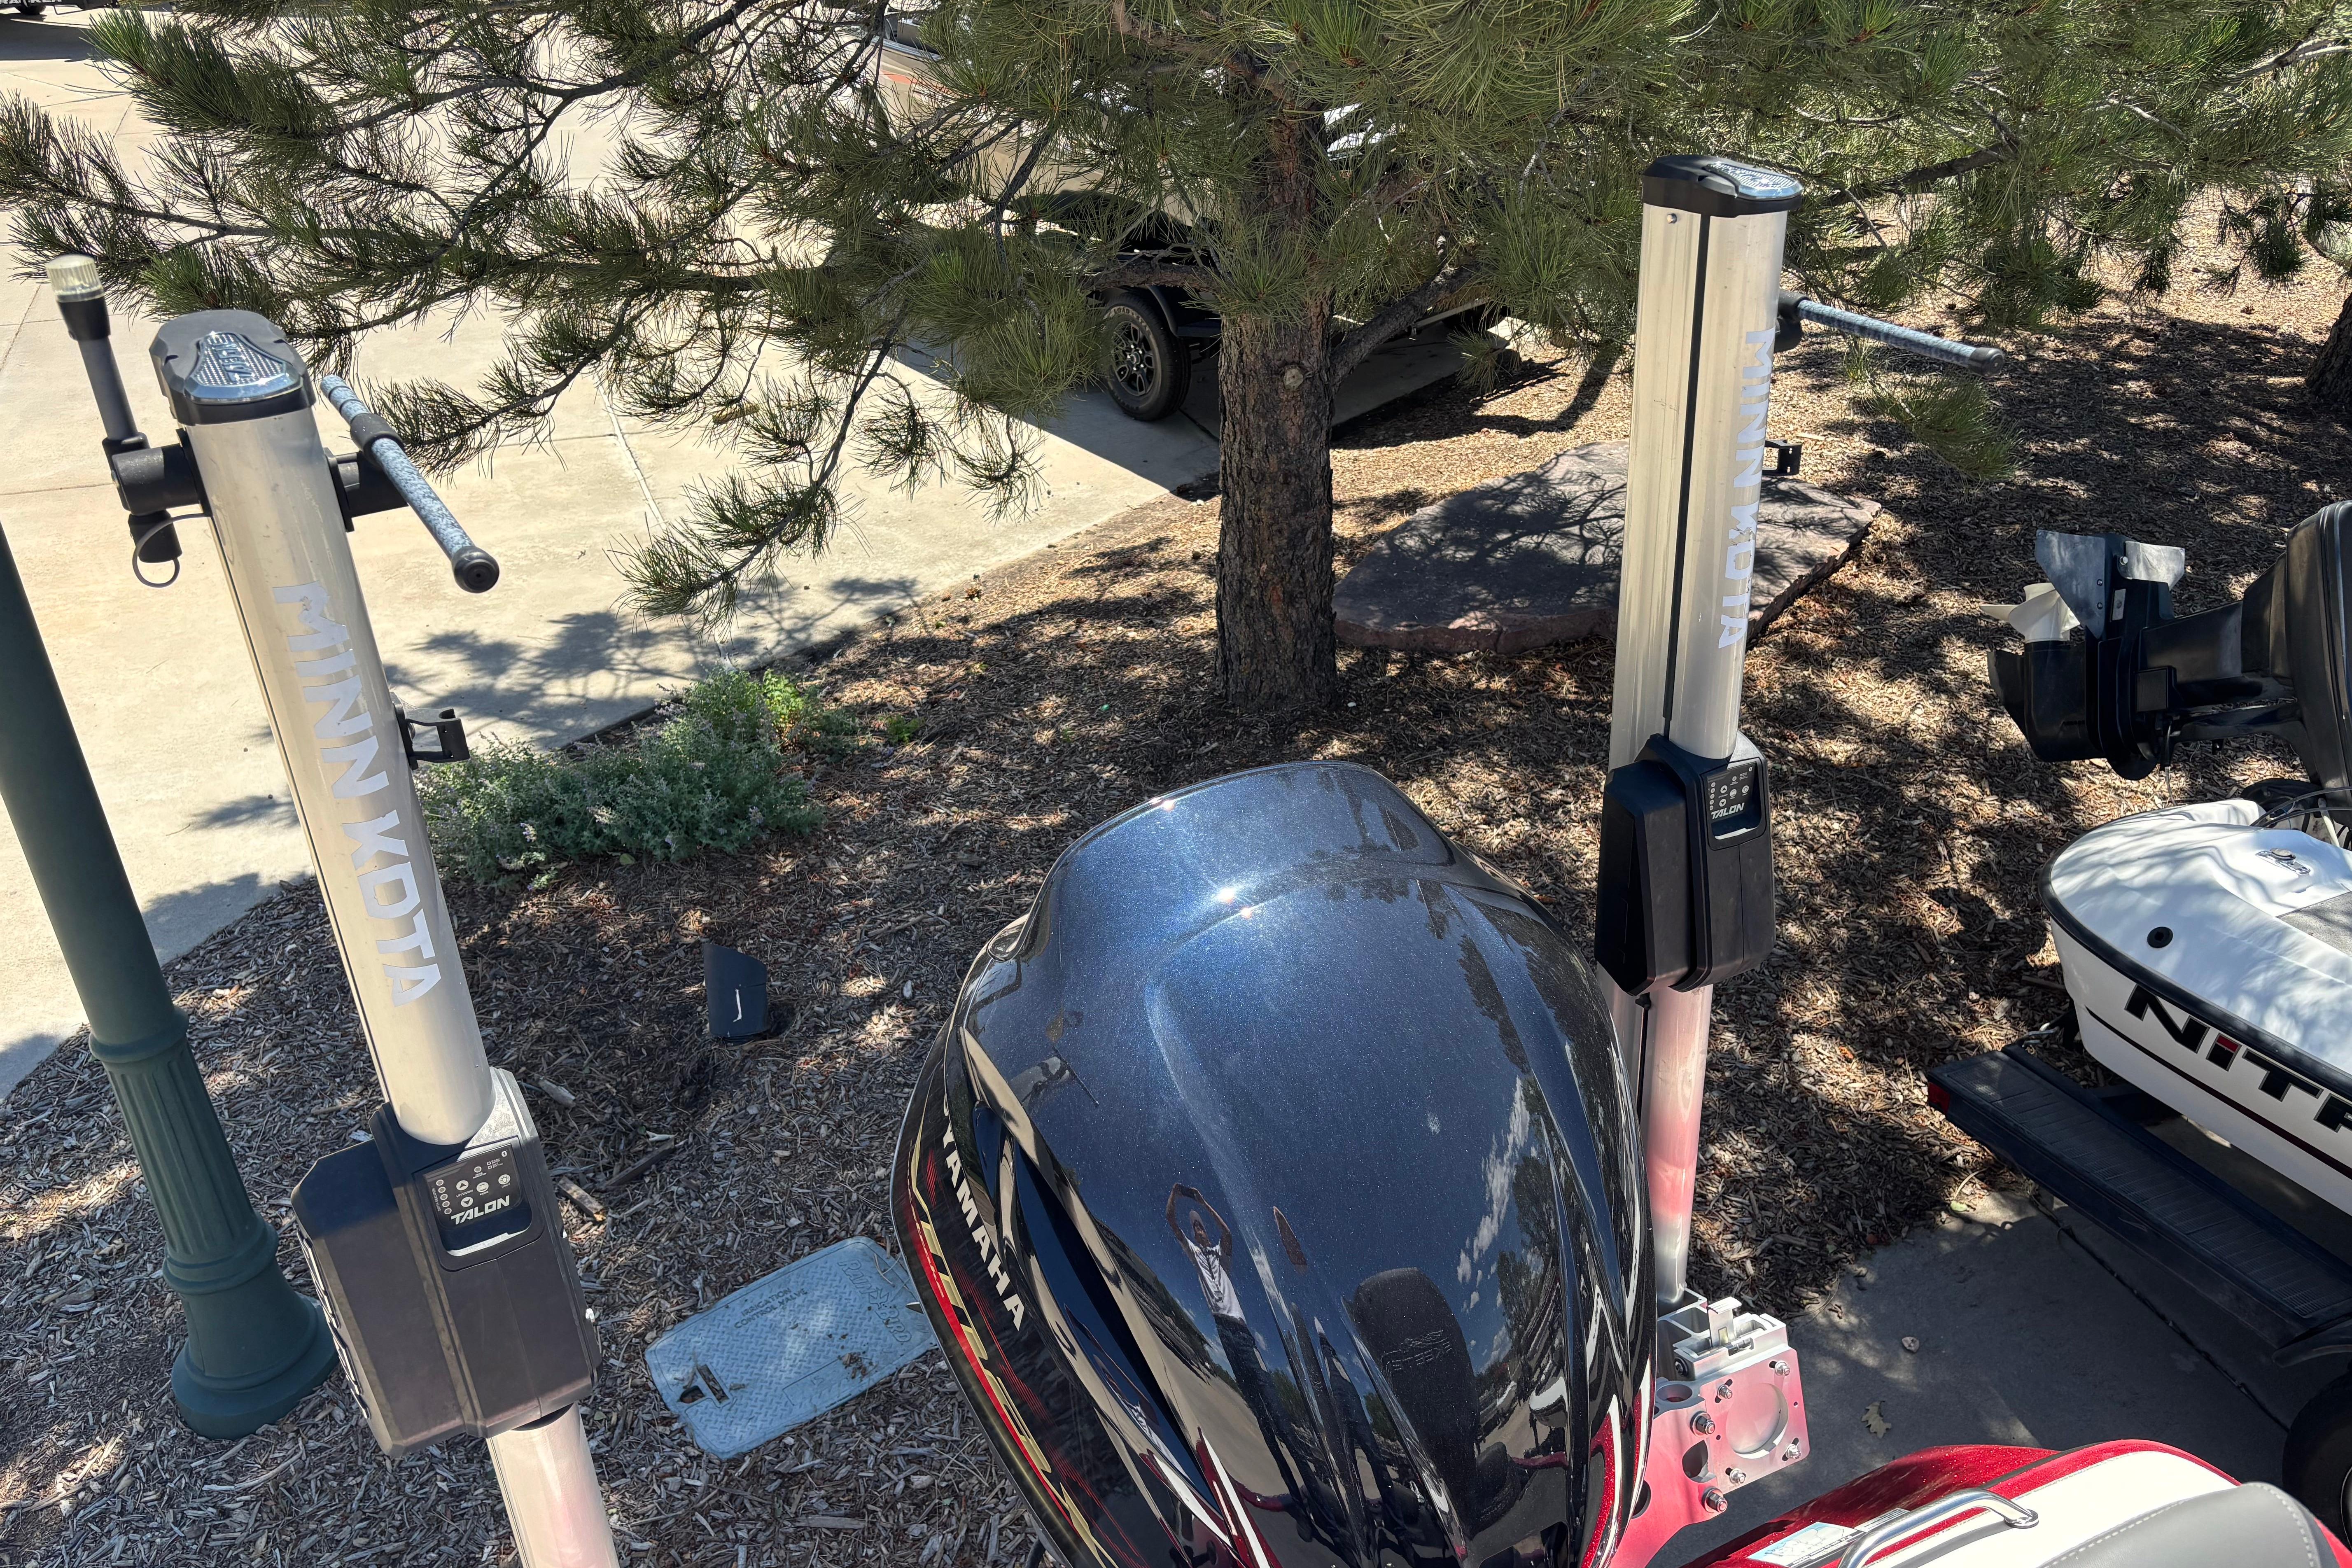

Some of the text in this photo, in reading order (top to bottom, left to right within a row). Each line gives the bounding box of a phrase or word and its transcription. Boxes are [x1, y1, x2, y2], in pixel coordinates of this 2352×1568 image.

[1718, 327, 1776, 648] MINN KOTA
[272, 581, 441, 1007] MINN KOTA
[1711, 803, 1745, 820] TALON
[451, 1195, 510, 1225] TALON
[943, 1123, 1025, 1331] YAMAHA
[734, 1288, 807, 1328] CONTROL VALVE
[837, 1259, 912, 1342] RAIN BIRD
